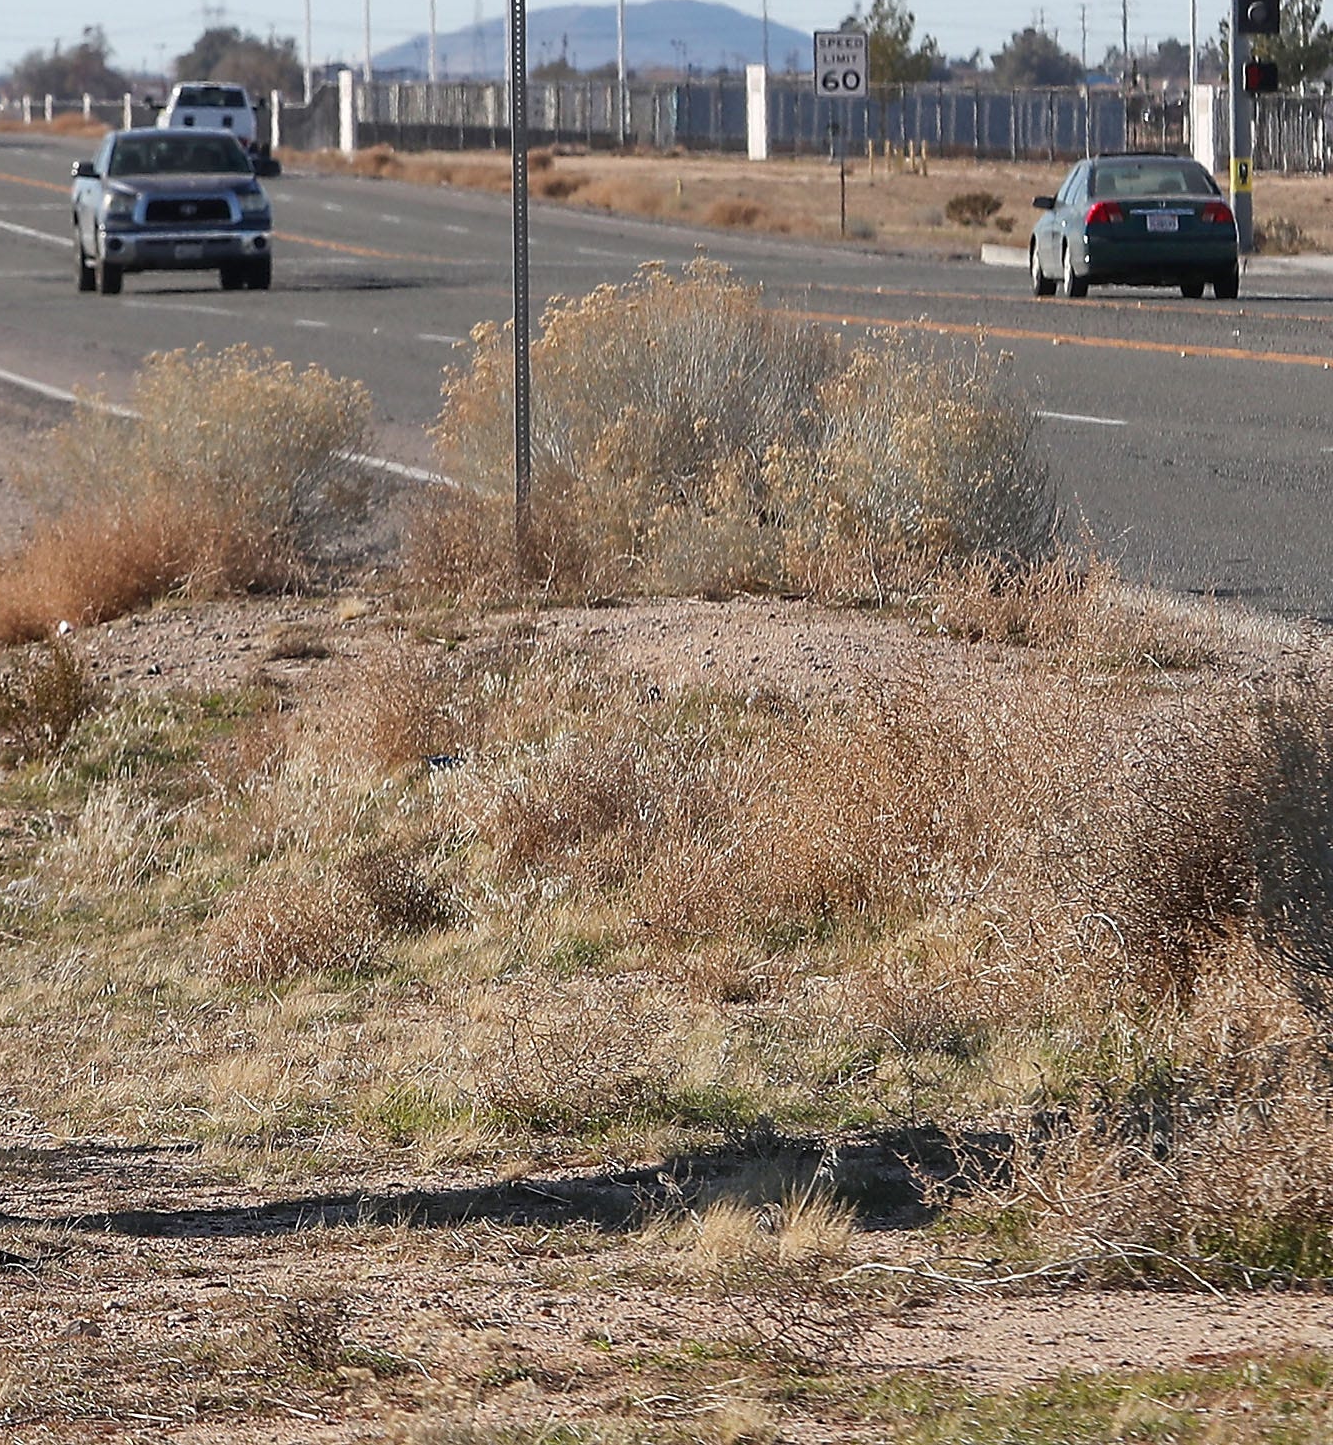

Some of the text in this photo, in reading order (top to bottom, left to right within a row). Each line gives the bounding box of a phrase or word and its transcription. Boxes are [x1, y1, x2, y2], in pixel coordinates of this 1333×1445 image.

[819, 38, 863, 49] SPEED
[823, 54, 857, 64] LIMIT
[822, 70, 861, 92] 60
